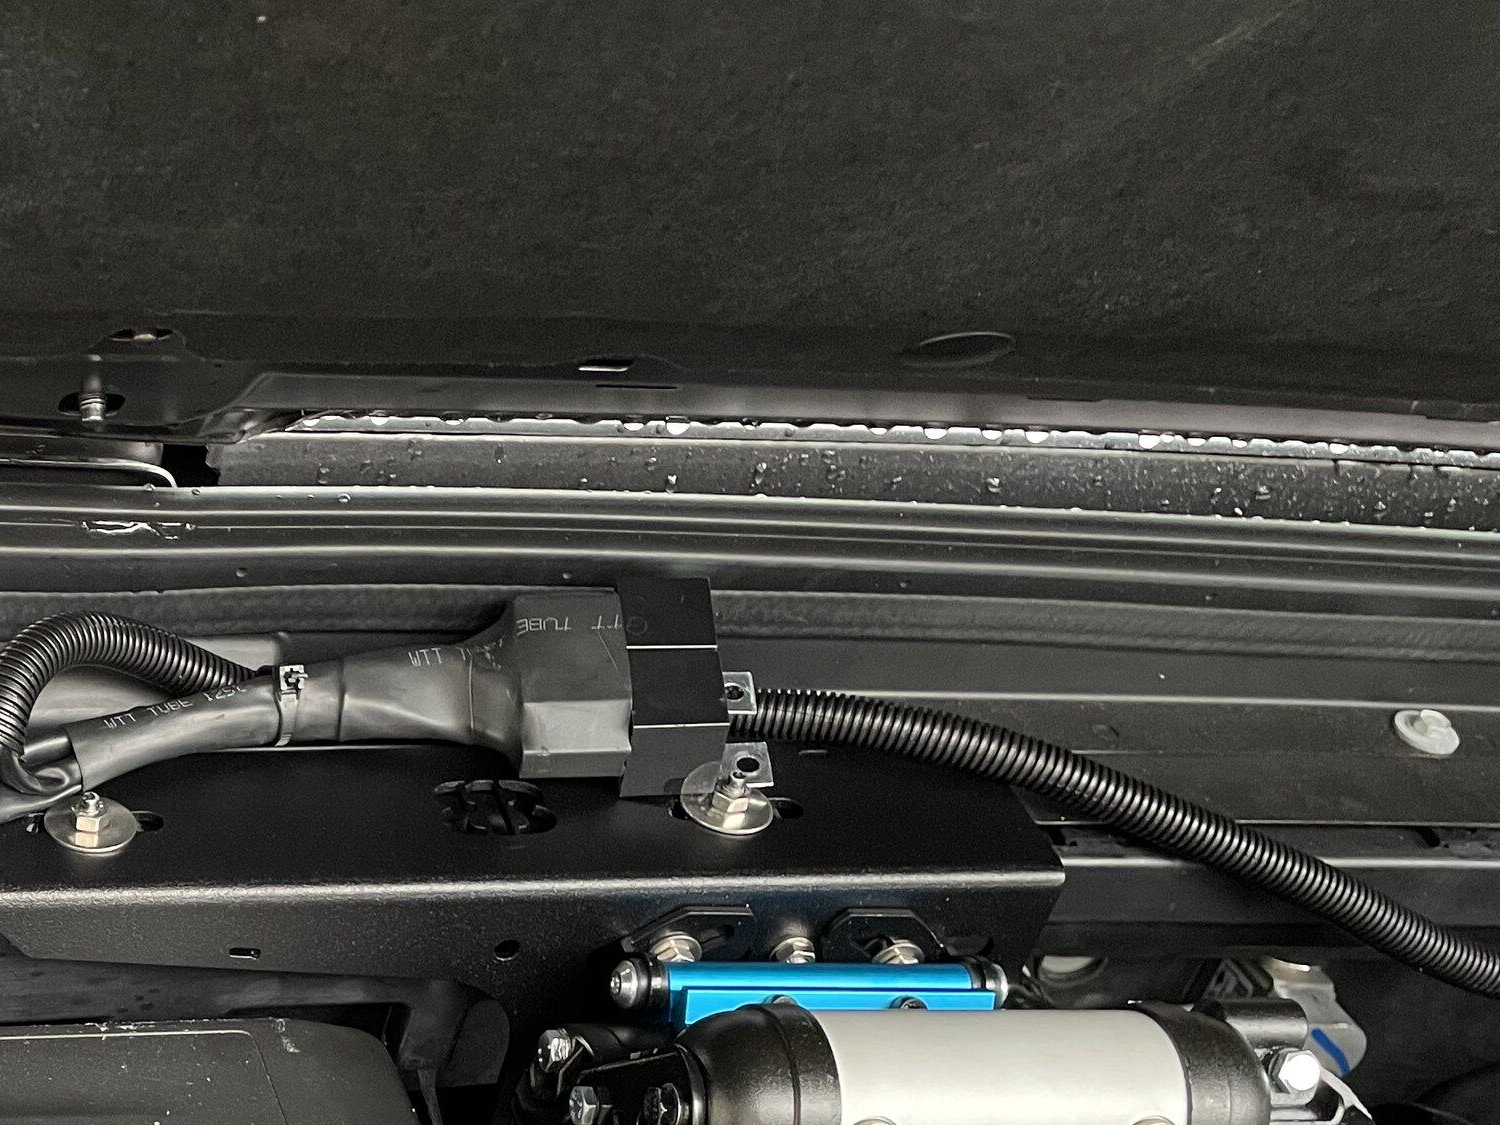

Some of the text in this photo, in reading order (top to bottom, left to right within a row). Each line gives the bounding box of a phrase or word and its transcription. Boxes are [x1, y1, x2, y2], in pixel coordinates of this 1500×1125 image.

[515, 616, 572, 637] TUBE
[407, 646, 442, 668] WTT
[102, 712, 138, 730] WTT
[146, 699, 194, 717] TUBE
